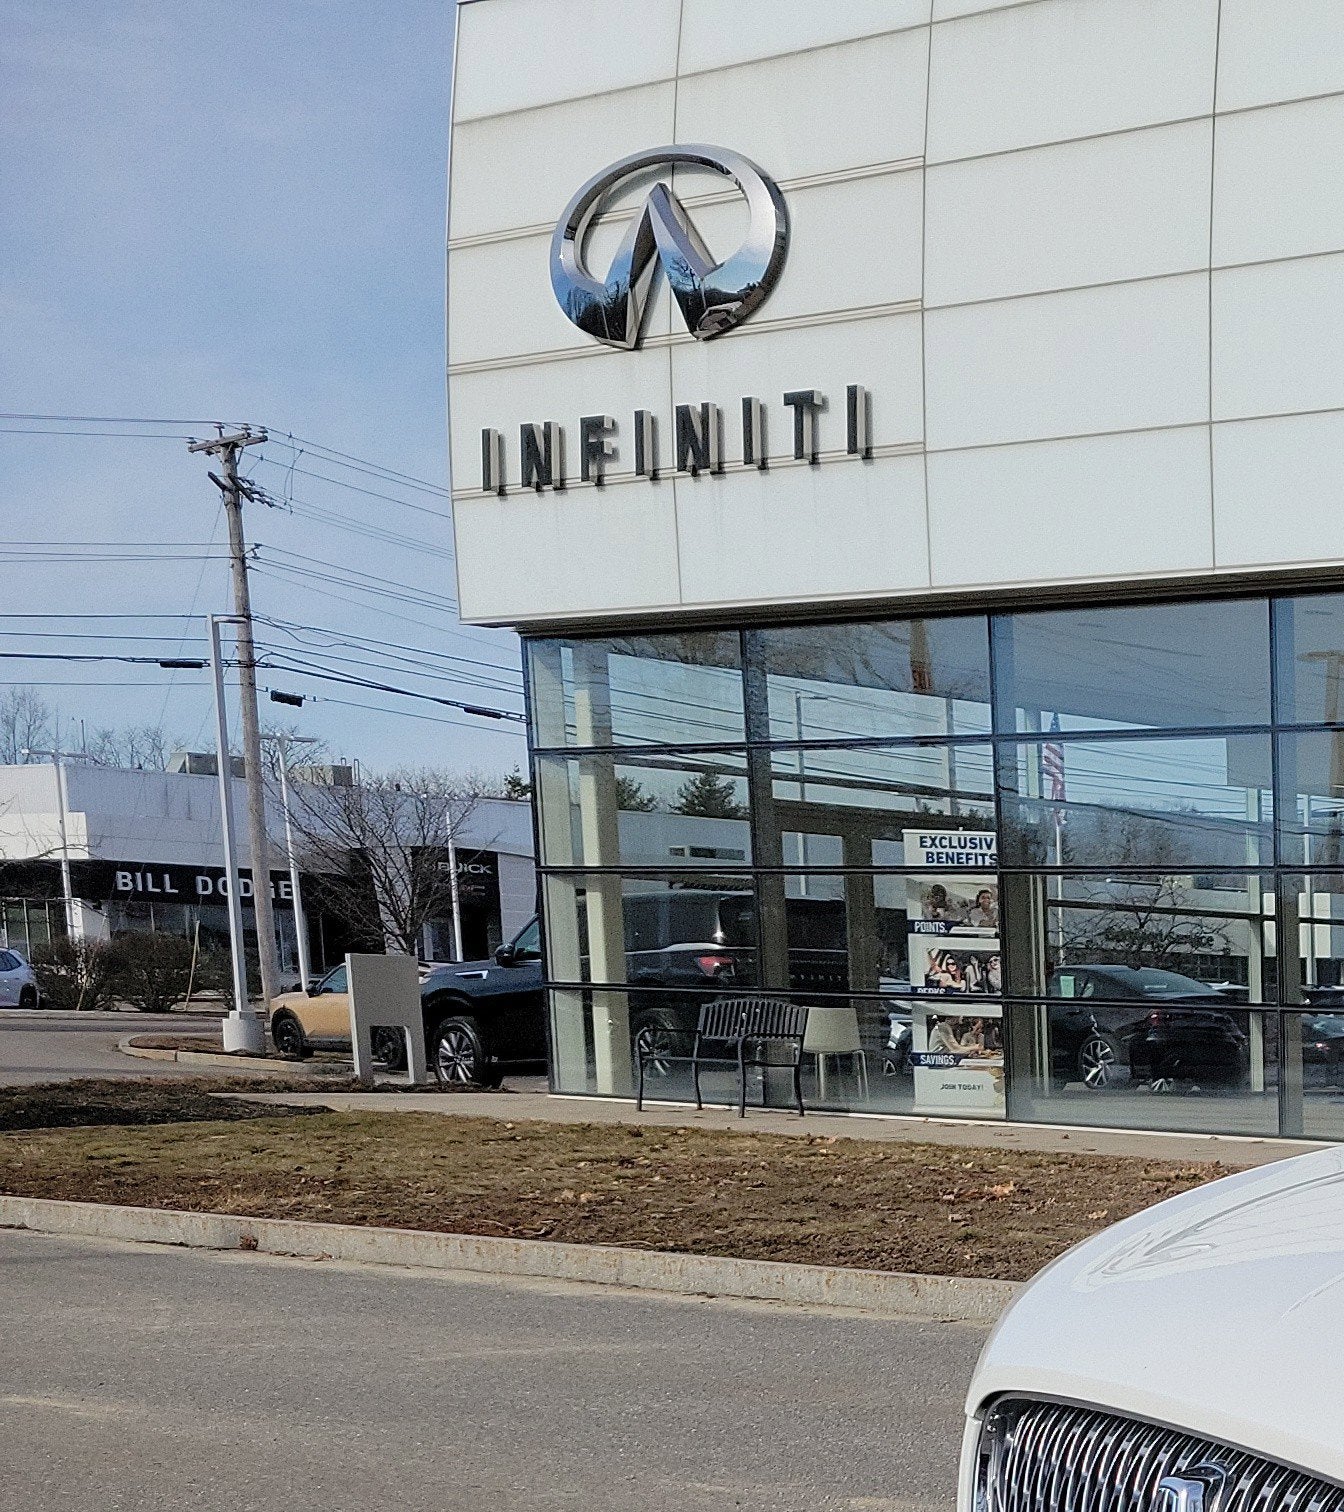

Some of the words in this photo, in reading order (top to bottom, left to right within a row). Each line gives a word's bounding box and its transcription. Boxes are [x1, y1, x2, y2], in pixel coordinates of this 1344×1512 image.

[481, 384, 870, 494] INFINITI
[925, 851, 998, 866] BENEFITS
[115, 870, 179, 894] BILL
[195, 875, 294, 900] DODE
